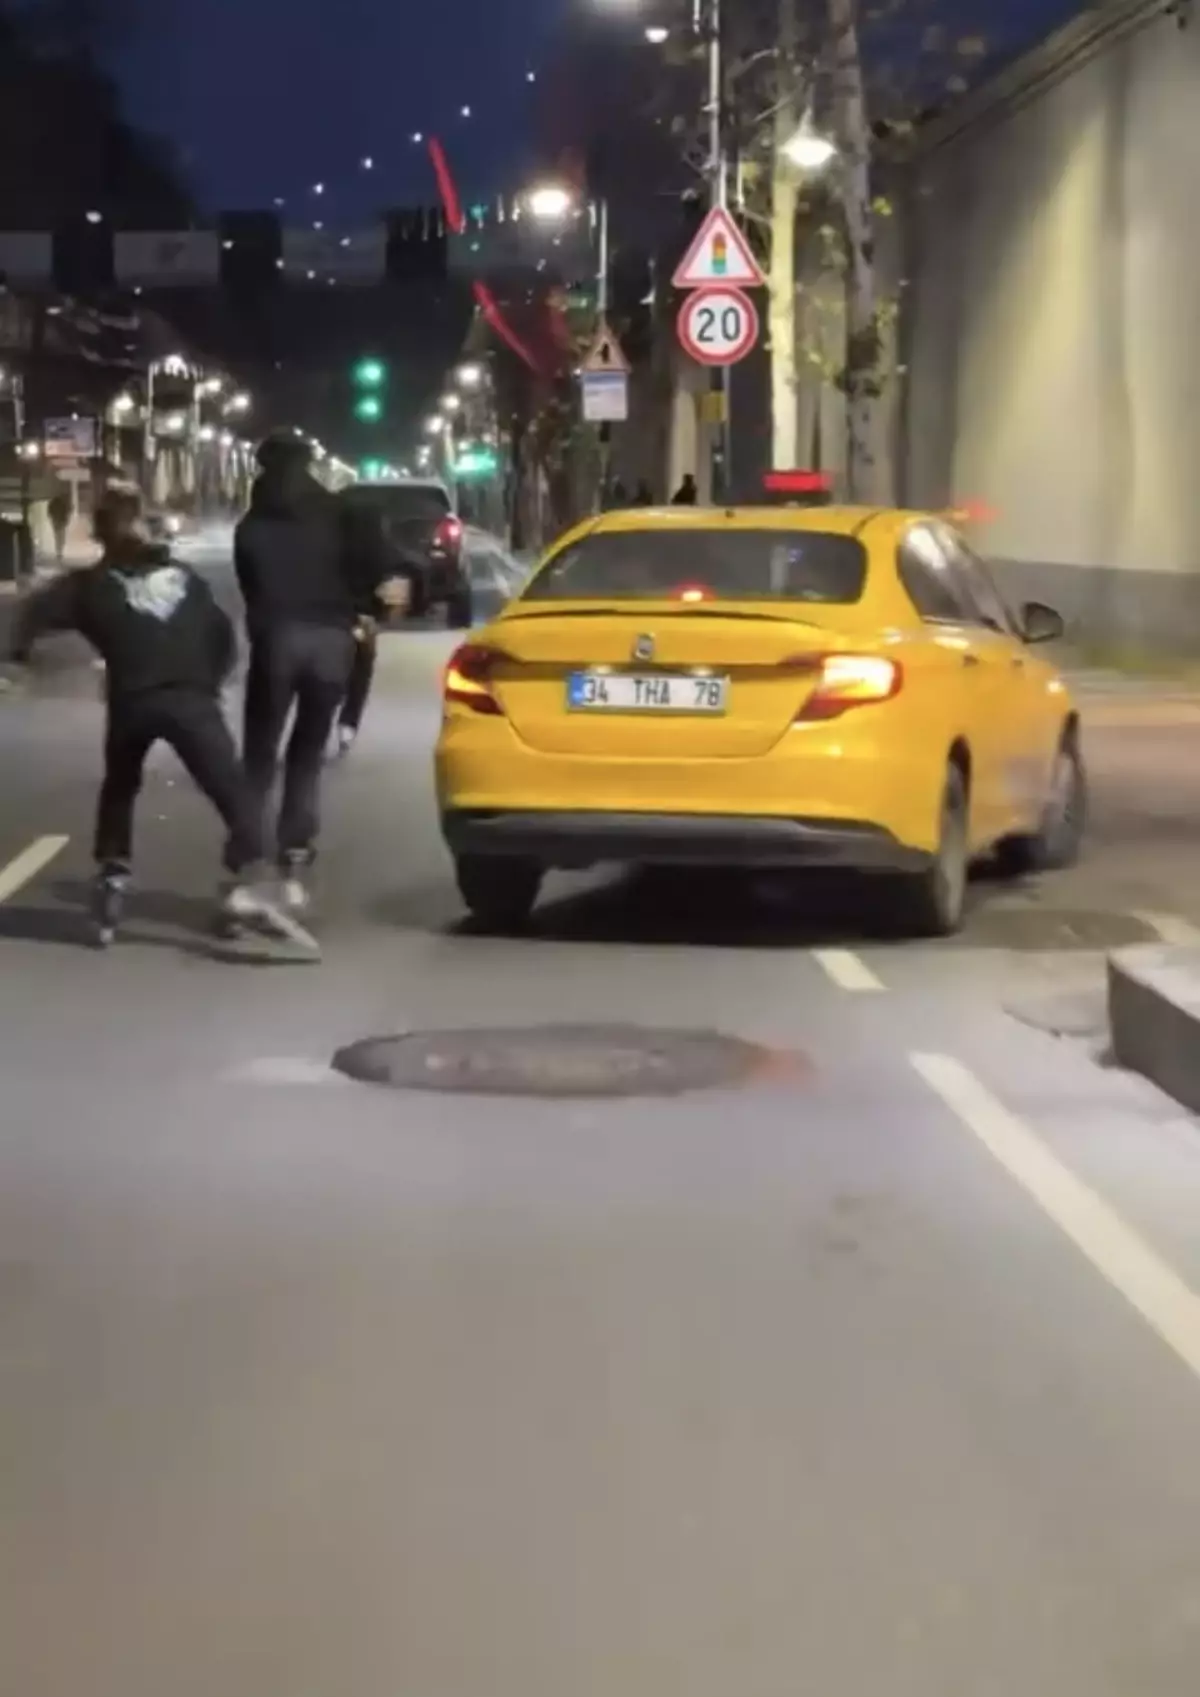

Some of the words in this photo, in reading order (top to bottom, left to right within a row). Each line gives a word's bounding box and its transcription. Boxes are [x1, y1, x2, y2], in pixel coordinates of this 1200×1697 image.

[696, 307, 741, 342] 20
[585, 679, 608, 703] 34
[694, 681, 721, 706] 78
